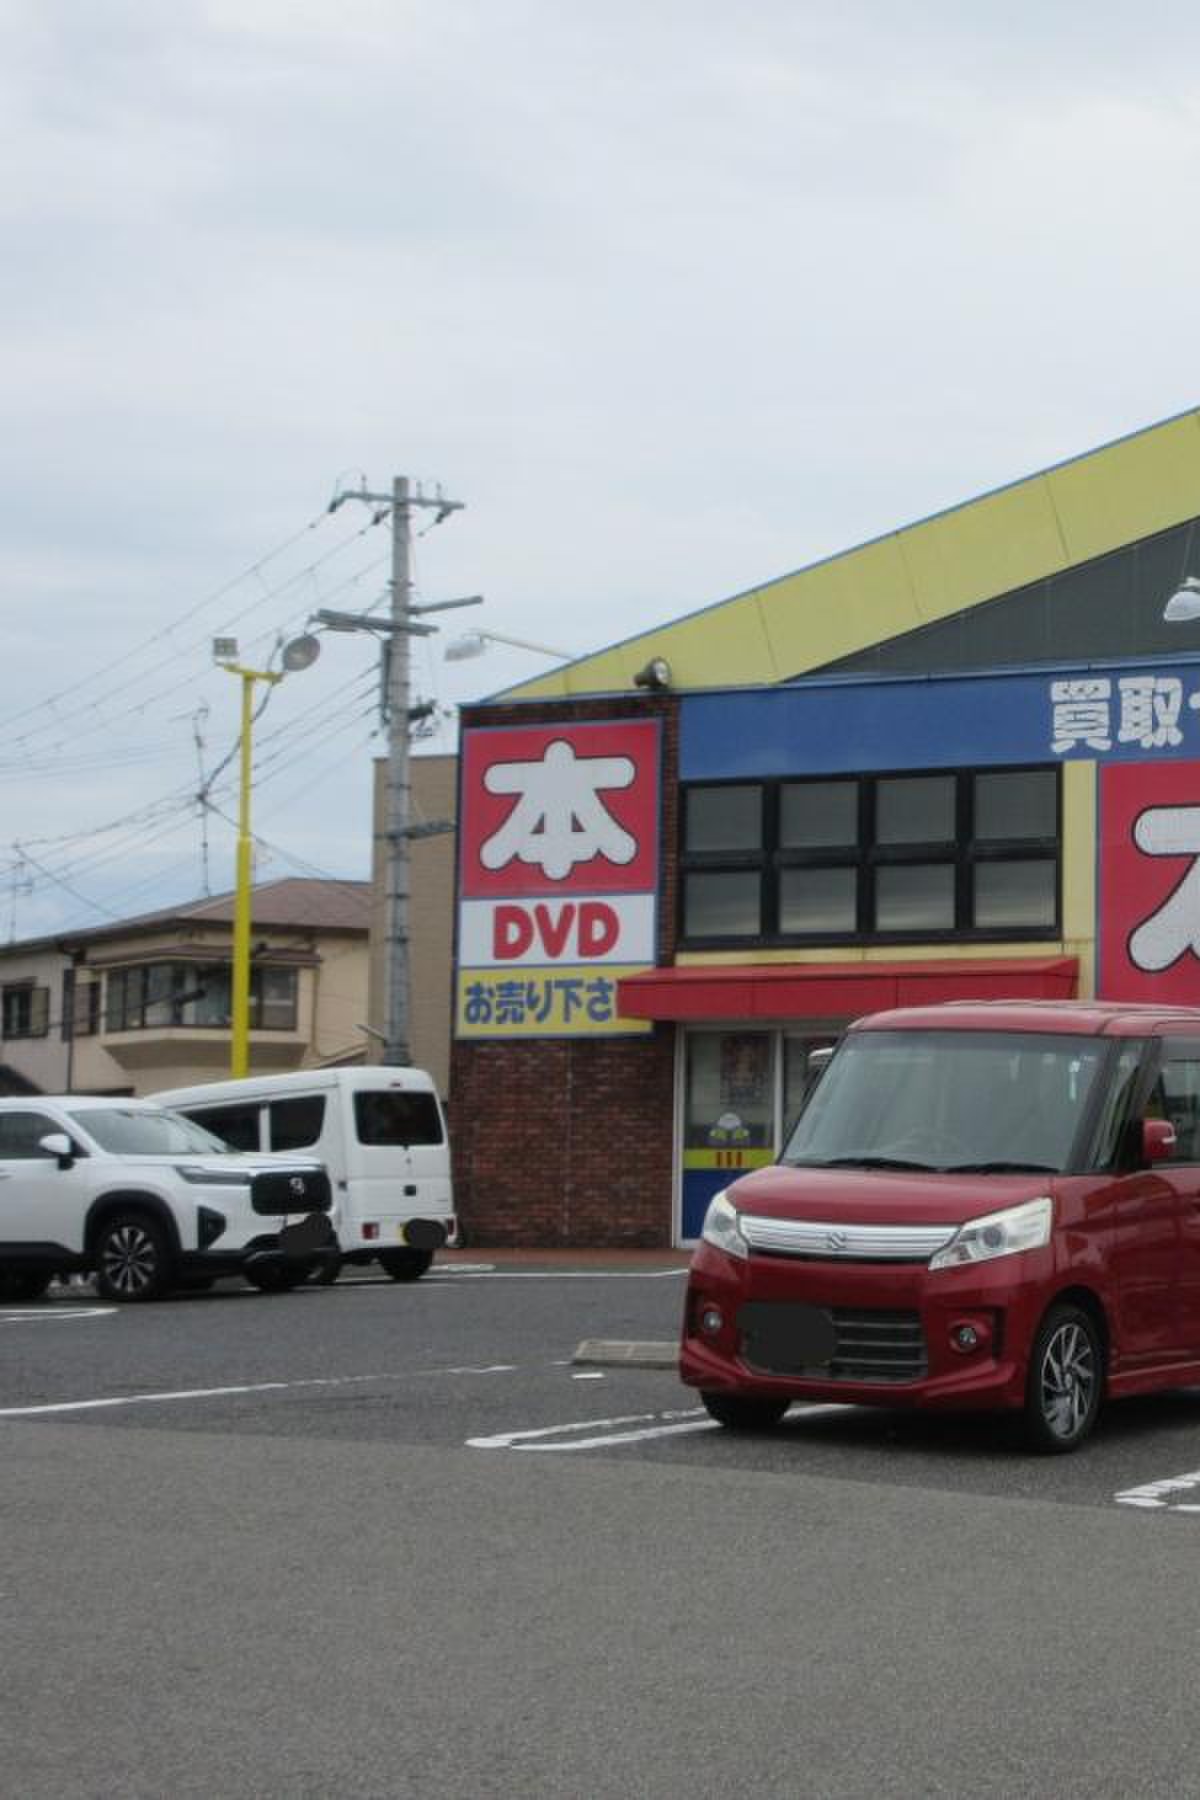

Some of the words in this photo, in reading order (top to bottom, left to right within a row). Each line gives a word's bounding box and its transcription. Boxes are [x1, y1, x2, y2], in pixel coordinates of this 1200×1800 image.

[481, 738, 638, 880] 本
[493, 902, 619, 960] DVD
[464, 976, 614, 1025] お売り下さ
